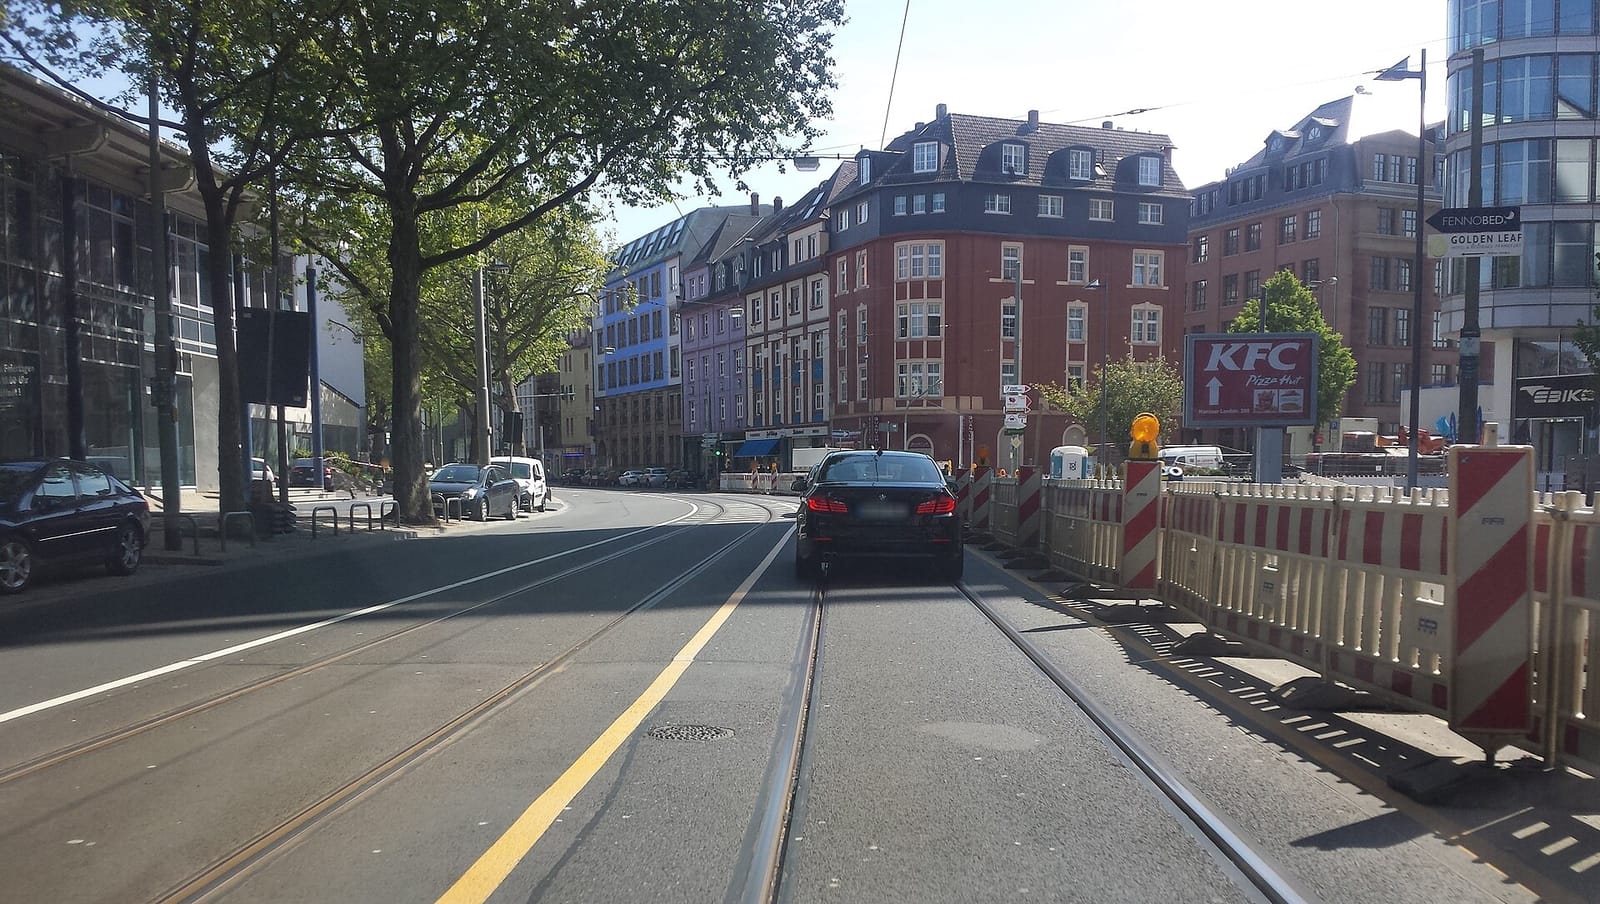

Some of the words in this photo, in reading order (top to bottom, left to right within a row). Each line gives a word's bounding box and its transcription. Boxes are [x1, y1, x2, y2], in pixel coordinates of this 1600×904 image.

[1442, 215, 1504, 226] FENNOBED
[1450, 234, 1493, 244] GOLDEN
[1498, 233, 1523, 243] LEAF
[1204, 342, 1301, 371] KFC
[1246, 375, 1278, 387] Pizza
[1279, 375, 1304, 386] Hut
